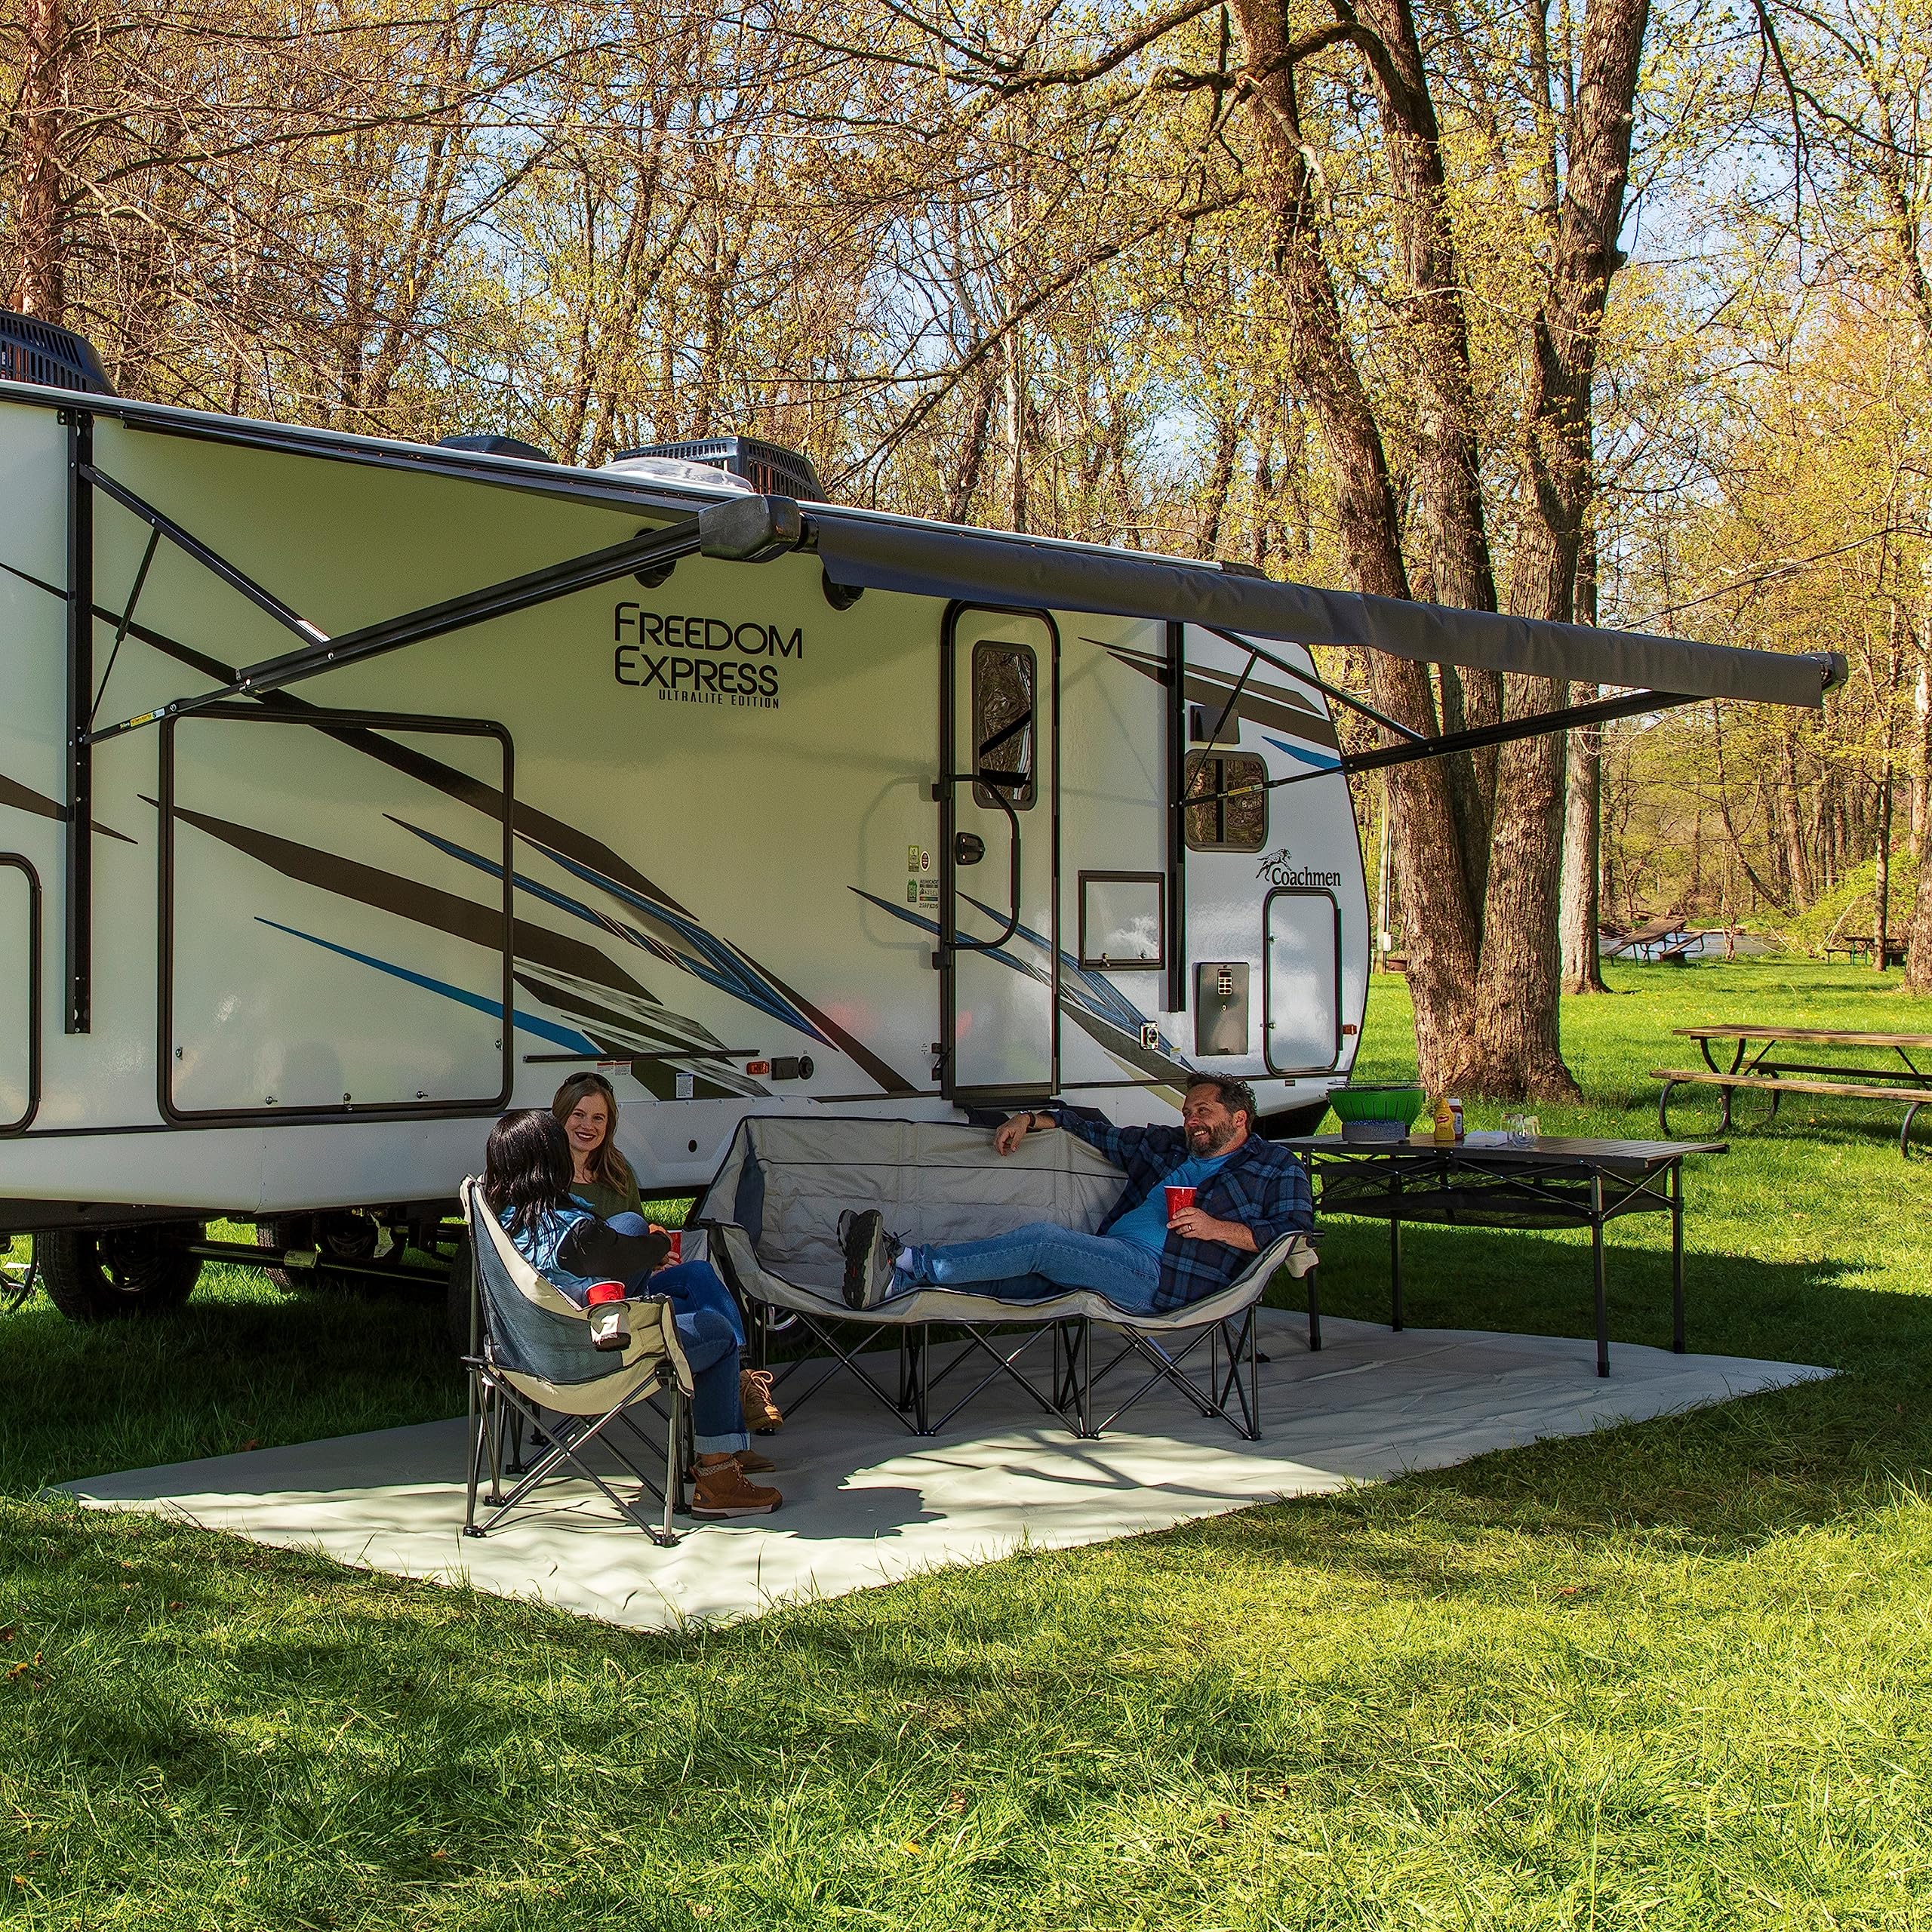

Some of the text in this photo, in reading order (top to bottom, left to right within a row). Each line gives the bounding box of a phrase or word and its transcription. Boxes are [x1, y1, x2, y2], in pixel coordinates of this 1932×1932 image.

[614, 601, 803, 659] FREEDOM
[614, 645, 779, 697] EXPRESS
[658, 688, 779, 709] ULTRALITE EDITION
[1271, 866, 1341, 887] Coachmen
